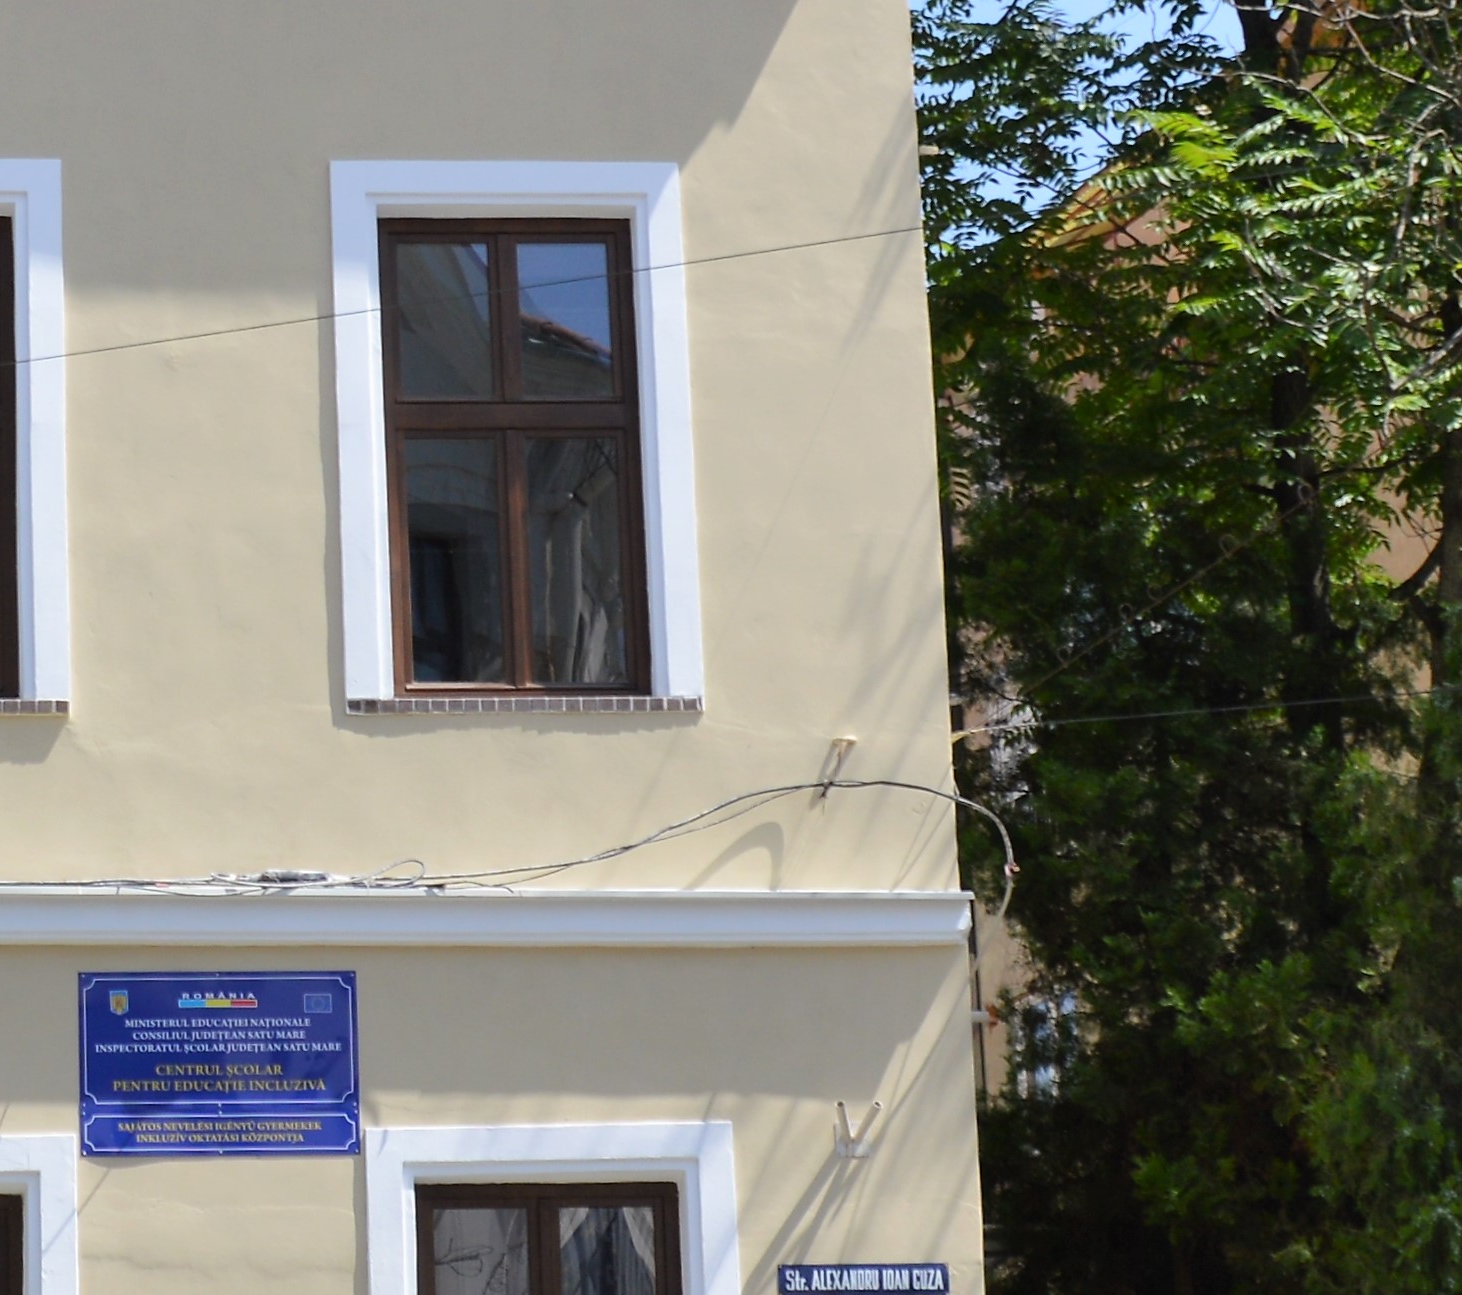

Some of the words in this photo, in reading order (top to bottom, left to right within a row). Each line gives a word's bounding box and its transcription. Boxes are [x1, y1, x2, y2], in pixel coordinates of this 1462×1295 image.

[124, 1018, 190, 1029] MINISTERUL
[132, 1031, 190, 1041] CONSILIUL
[247, 1030, 275, 1040] SATU
[276, 1030, 307, 1040] MARE
[94, 1043, 184, 1054] INSPECTORATUL
[283, 1042, 312, 1052] SATU
[312, 1042, 343, 1052] MARE
[155, 1064, 224, 1076] CENTRUL
[112, 1080, 171, 1092] PENTRU
[257, 1120, 323, 1131] GYERMEKEK
[135, 1132, 187, 1144] INKLUZÍV
[188, 1132, 240, 1143] OKTATÁSI
[785, 1270, 809, 1292] Str.
[811, 1268, 880, 1292] ALEXANDRU
[882, 1268, 910, 1291] IOAN
[911, 1268, 945, 1291] CUZA
